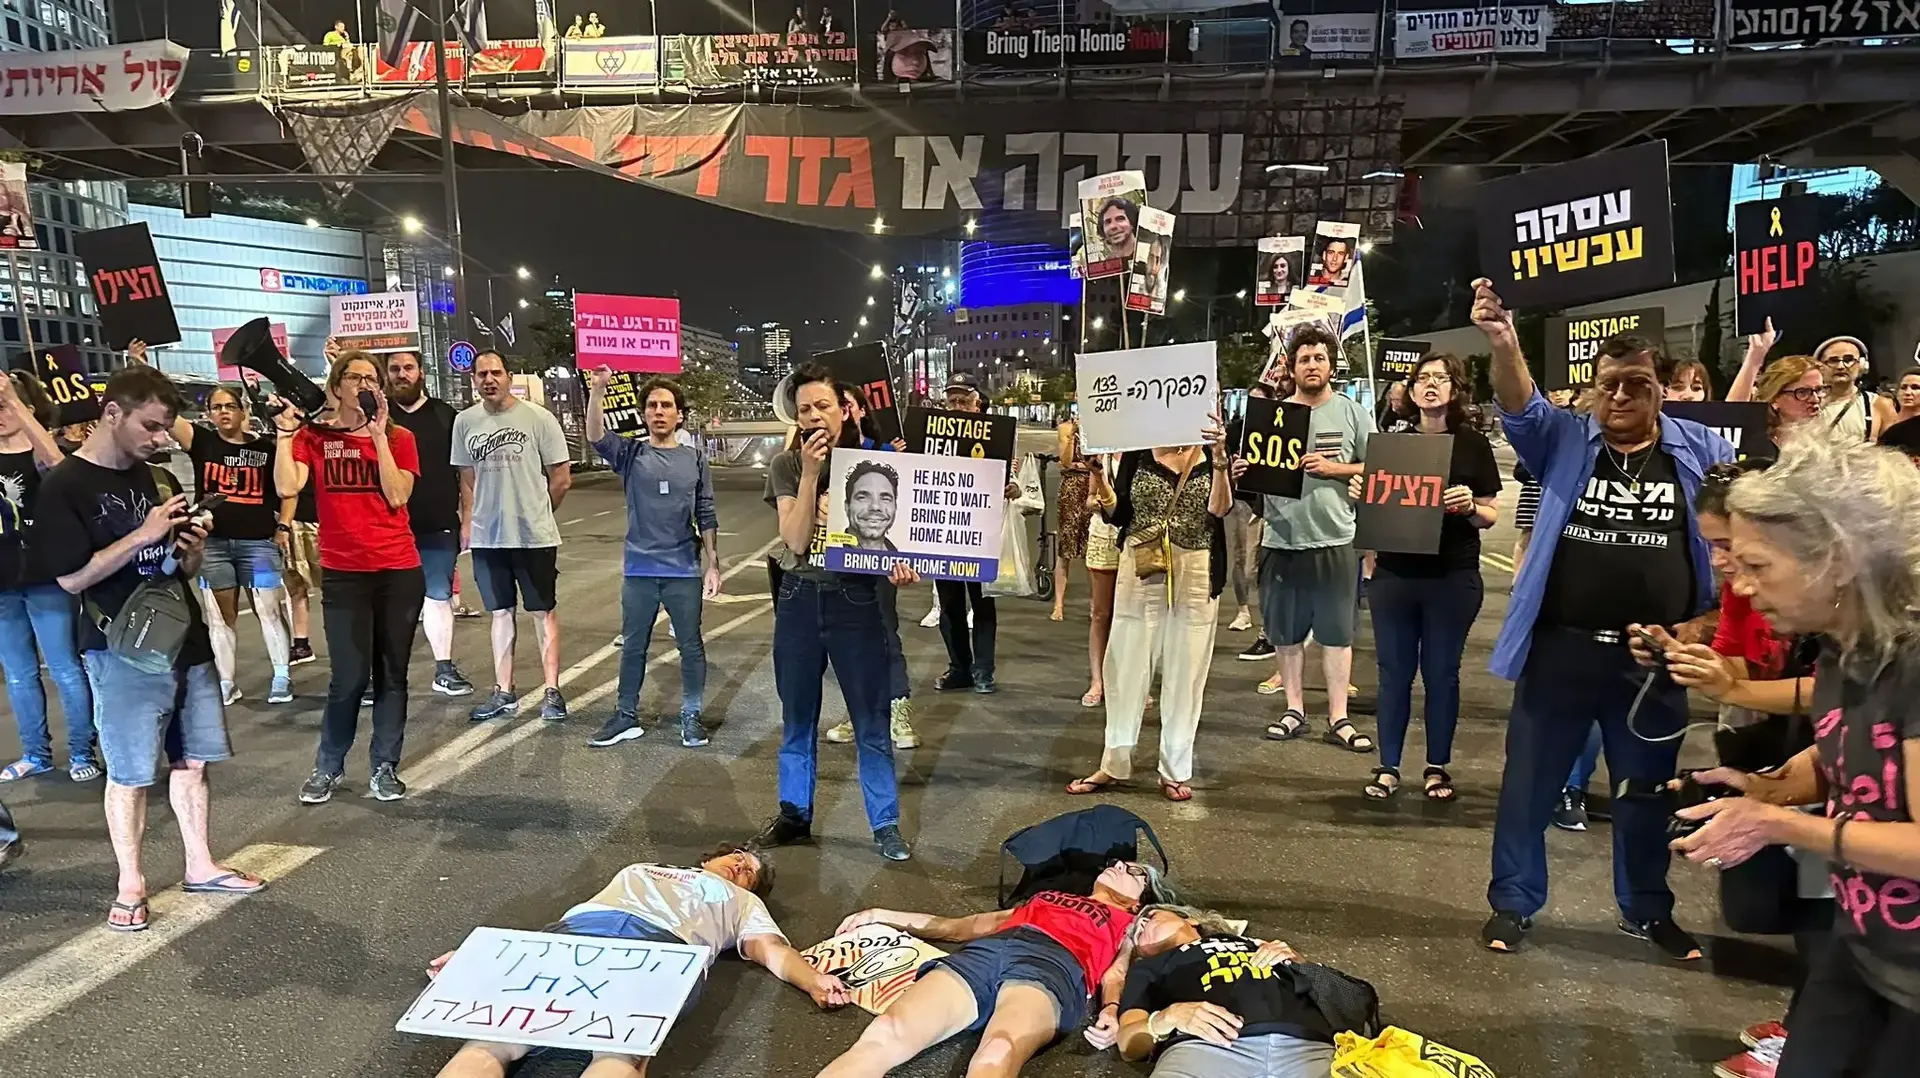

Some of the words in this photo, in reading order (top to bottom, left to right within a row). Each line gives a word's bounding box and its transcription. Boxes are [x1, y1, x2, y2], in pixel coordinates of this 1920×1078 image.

[1406, 11, 1459, 31] חוזרים
[1463, 8, 1514, 28] שכולם
[1518, 8, 1541, 26] עד
[987, 31, 1028, 58] Bring
[1032, 30, 1076, 53] Them
[1080, 29, 1126, 52] Home
[1433, 29, 1495, 50] חטופים
[1500, 27, 1539, 46] כולנו
[0, 63, 106, 97] אחיות
[124, 50, 182, 97] קול
[745, 135, 876, 208] גזר
[895, 135, 985, 210] או
[1004, 132, 1245, 230] עסקה
[1515, 189, 1631, 243] עסקה
[1511, 226, 1643, 281] עכשיו!
[1741, 241, 1814, 295] HELP
[92, 265, 162, 305] הצילו
[341, 300, 384, 311] אייזנקוט
[390, 309, 403, 319] לא
[344, 311, 387, 321] מפקירים
[375, 320, 409, 330] שבויים
[577, 312, 619, 328] גורלי
[622, 315, 653, 330] רגע
[657, 318, 677, 331] זה
[1568, 315, 1640, 341] HOSTAGE
[586, 335, 618, 348] מוות
[621, 337, 636, 348] או
[640, 338, 670, 350] חיים
[1568, 339, 1605, 361] DEA
[1385, 350, 1420, 362] עסקה
[1382, 361, 1417, 372] כשיו!
[1568, 362, 1593, 384] NO
[1093, 375, 1118, 393] 133
[1095, 397, 1118, 413] 201
[926, 415, 993, 440] HOSTAGE
[324, 441, 344, 449] BRING
[325, 449, 341, 459] THEM
[342, 449, 361, 458] HOME
[924, 436, 958, 457] DEAL
[1246, 431, 1302, 471] S.O.S
[323, 459, 381, 486] NOW
[913, 470, 929, 485] HE
[932, 470, 956, 487] HAS
[958, 472, 974, 488] NO
[1366, 469, 1442, 507] הצילו
[912, 489, 940, 506] TIME
[943, 491, 957, 507] TO
[961, 493, 991, 509] WAIT.
[1577, 498, 1634, 520] בלפו
[911, 508, 946, 524] BRING
[949, 511, 971, 526] HIM
[1642, 506, 1675, 520] על
[909, 526, 944, 544] HOME
[946, 529, 982, 546] ALIVE!
[1563, 525, 1618, 543] הפגנות
[1626, 532, 1668, 547] מוקד
[844, 553, 879, 570] BRING
[913, 558, 946, 575] HOME
[949, 560, 981, 577] NOW!
[496, 938, 697, 976] הפסיקו
[501, 972, 610, 999] את
[405, 982, 668, 1045] המלחמה!
